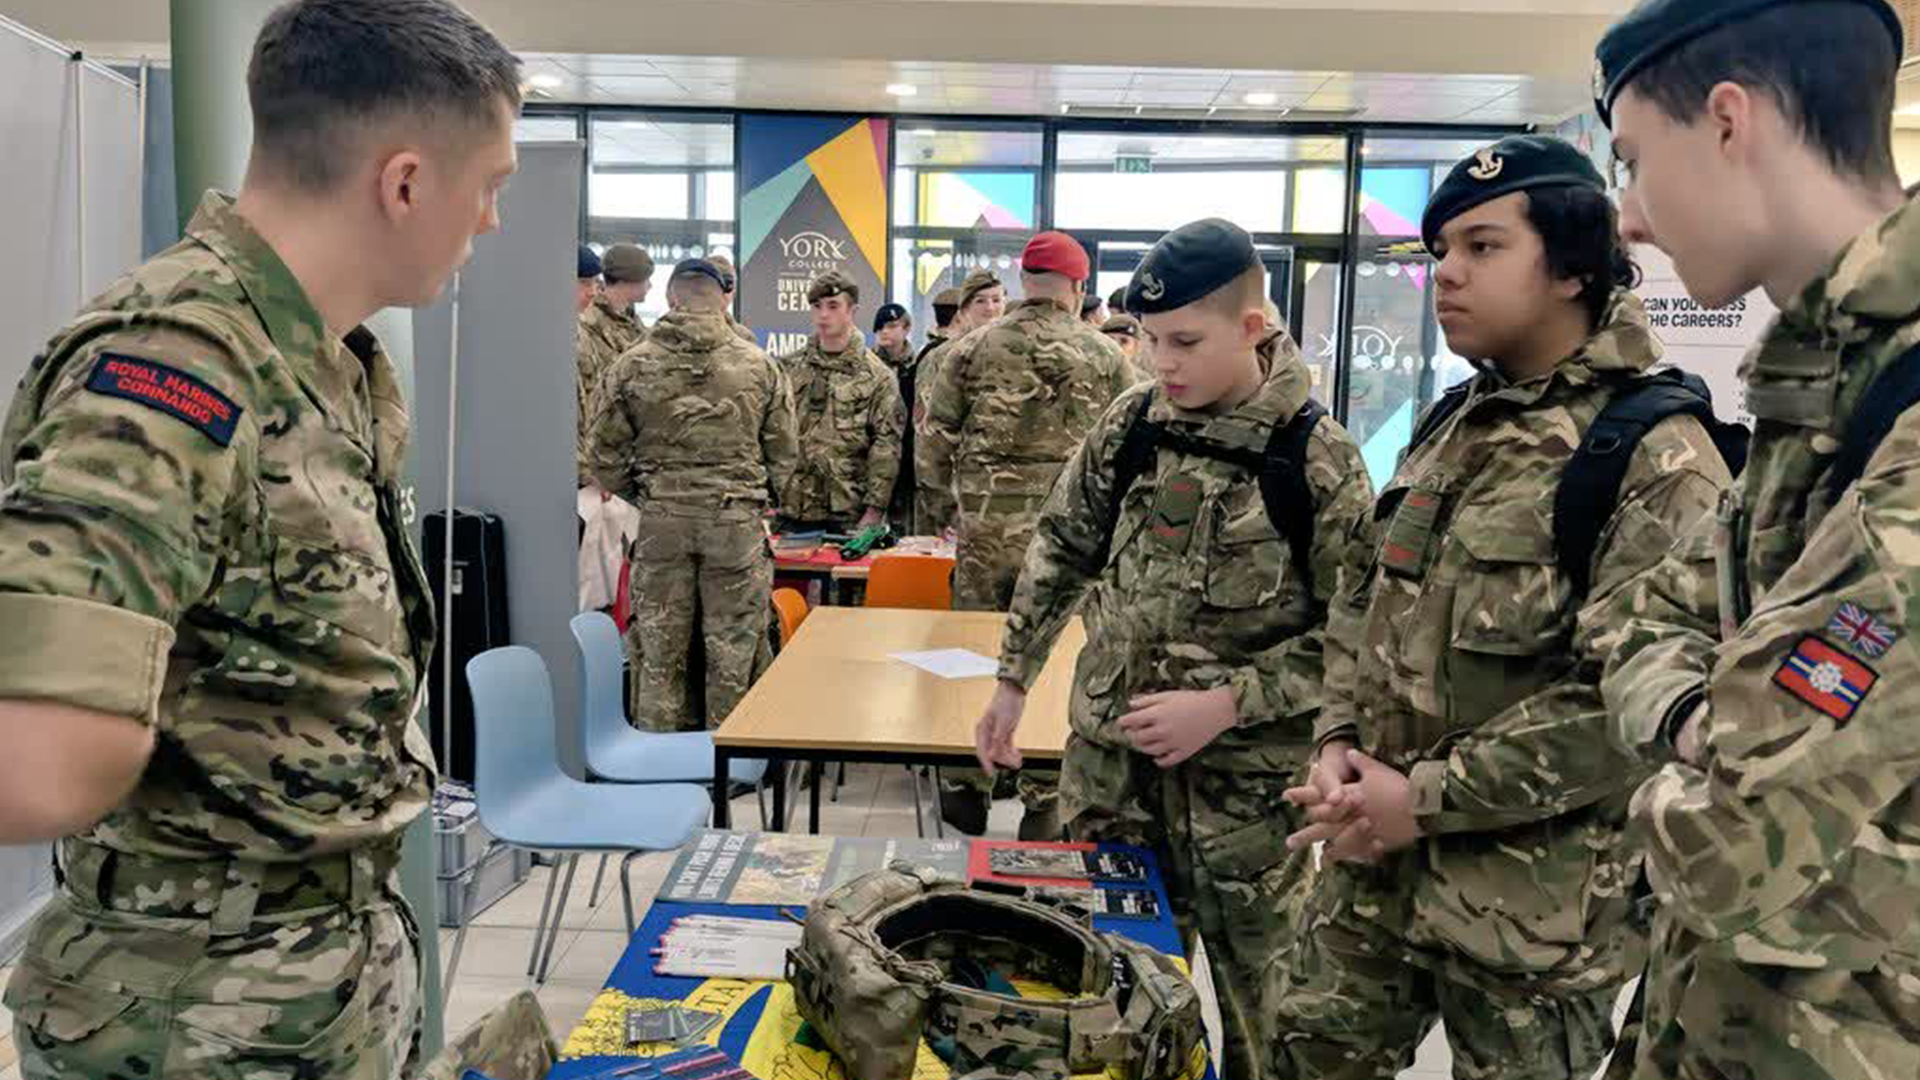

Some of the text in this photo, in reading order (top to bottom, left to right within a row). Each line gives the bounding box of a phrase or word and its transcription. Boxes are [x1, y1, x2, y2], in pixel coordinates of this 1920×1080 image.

[779, 232, 847, 260] YORK
[788, 260, 838, 270] COLLEGE
[778, 292, 811, 311] CEN
[104, 361, 231, 420] ROYAL MARINES
[117, 378, 213, 423] COMMANDO
